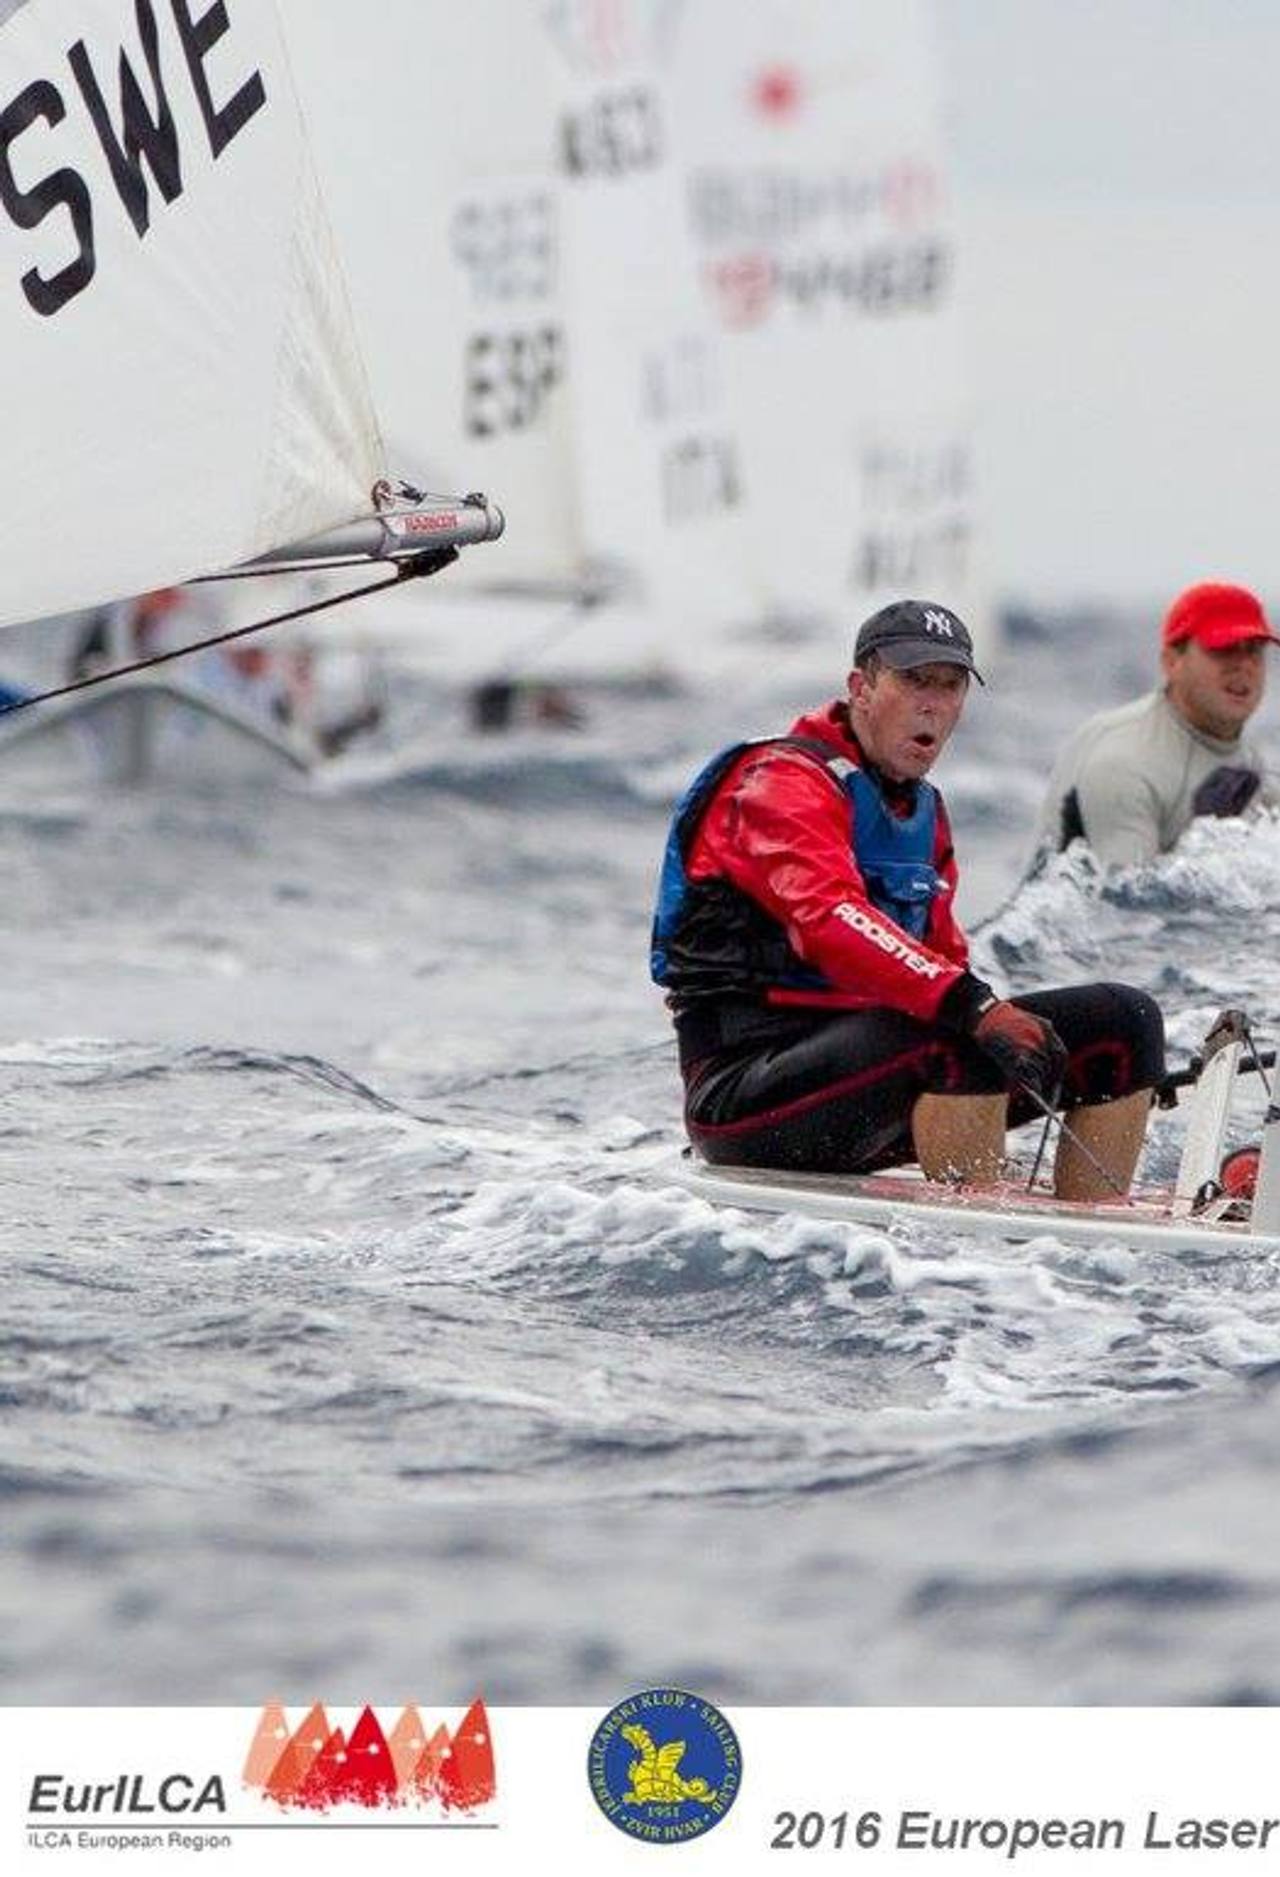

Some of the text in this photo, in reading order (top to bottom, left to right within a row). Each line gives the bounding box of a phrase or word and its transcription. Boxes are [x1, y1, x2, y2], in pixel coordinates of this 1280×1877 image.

[0, 0, 266, 316] SWE
[924, 610, 953, 637] NY
[832, 902, 941, 979] ROOSTER
